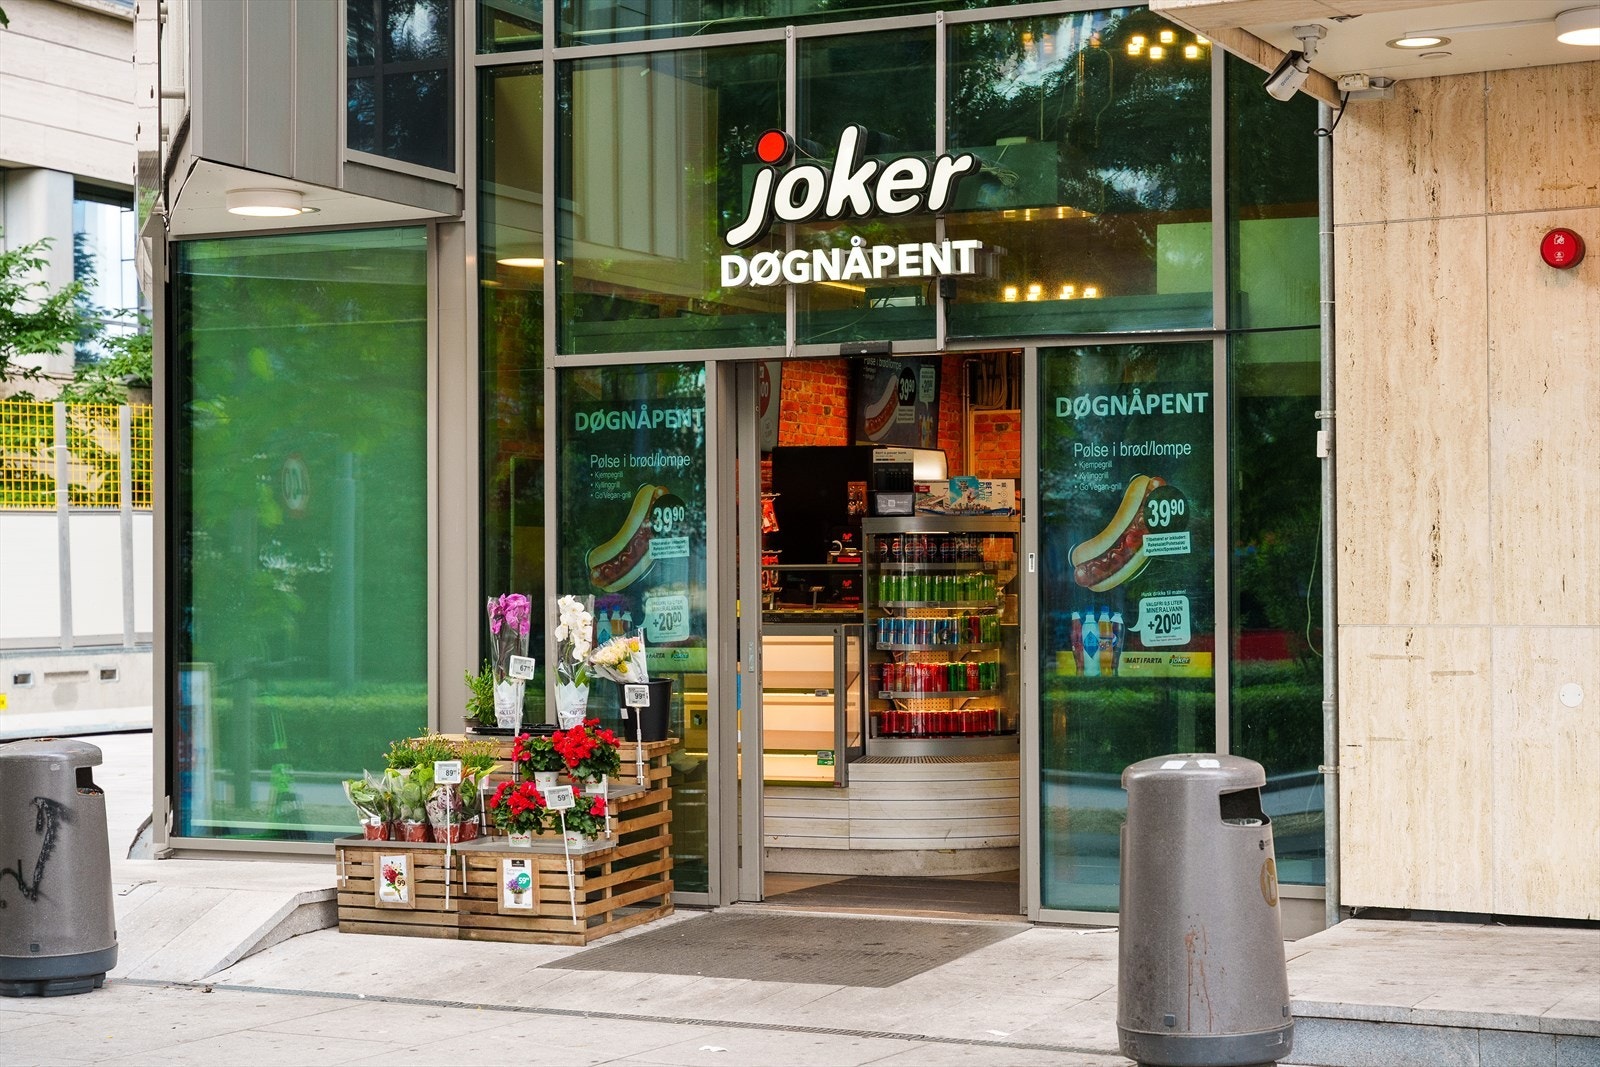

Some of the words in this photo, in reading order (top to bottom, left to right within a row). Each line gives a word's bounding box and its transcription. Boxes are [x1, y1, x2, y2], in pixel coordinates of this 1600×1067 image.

[724, 123, 978, 248] joker
[720, 235, 982, 288] DØGNÅPENT
[1055, 387, 1209, 420] DØGNÅPENT
[575, 403, 705, 434] DØGNÅPENT
[590, 453, 620, 468] Pølse
[623, 453, 627, 467] i
[629, 452, 691, 469] brød/lompe
[1074, 442, 1109, 457] Pølse
[1112, 442, 1116, 456] i
[1120, 440, 1192, 459] brød/lompe
[1079, 460, 1113, 470] Kjempegrill
[653, 506, 685, 532] 3990
[1147, 498, 1185, 527] 3990
